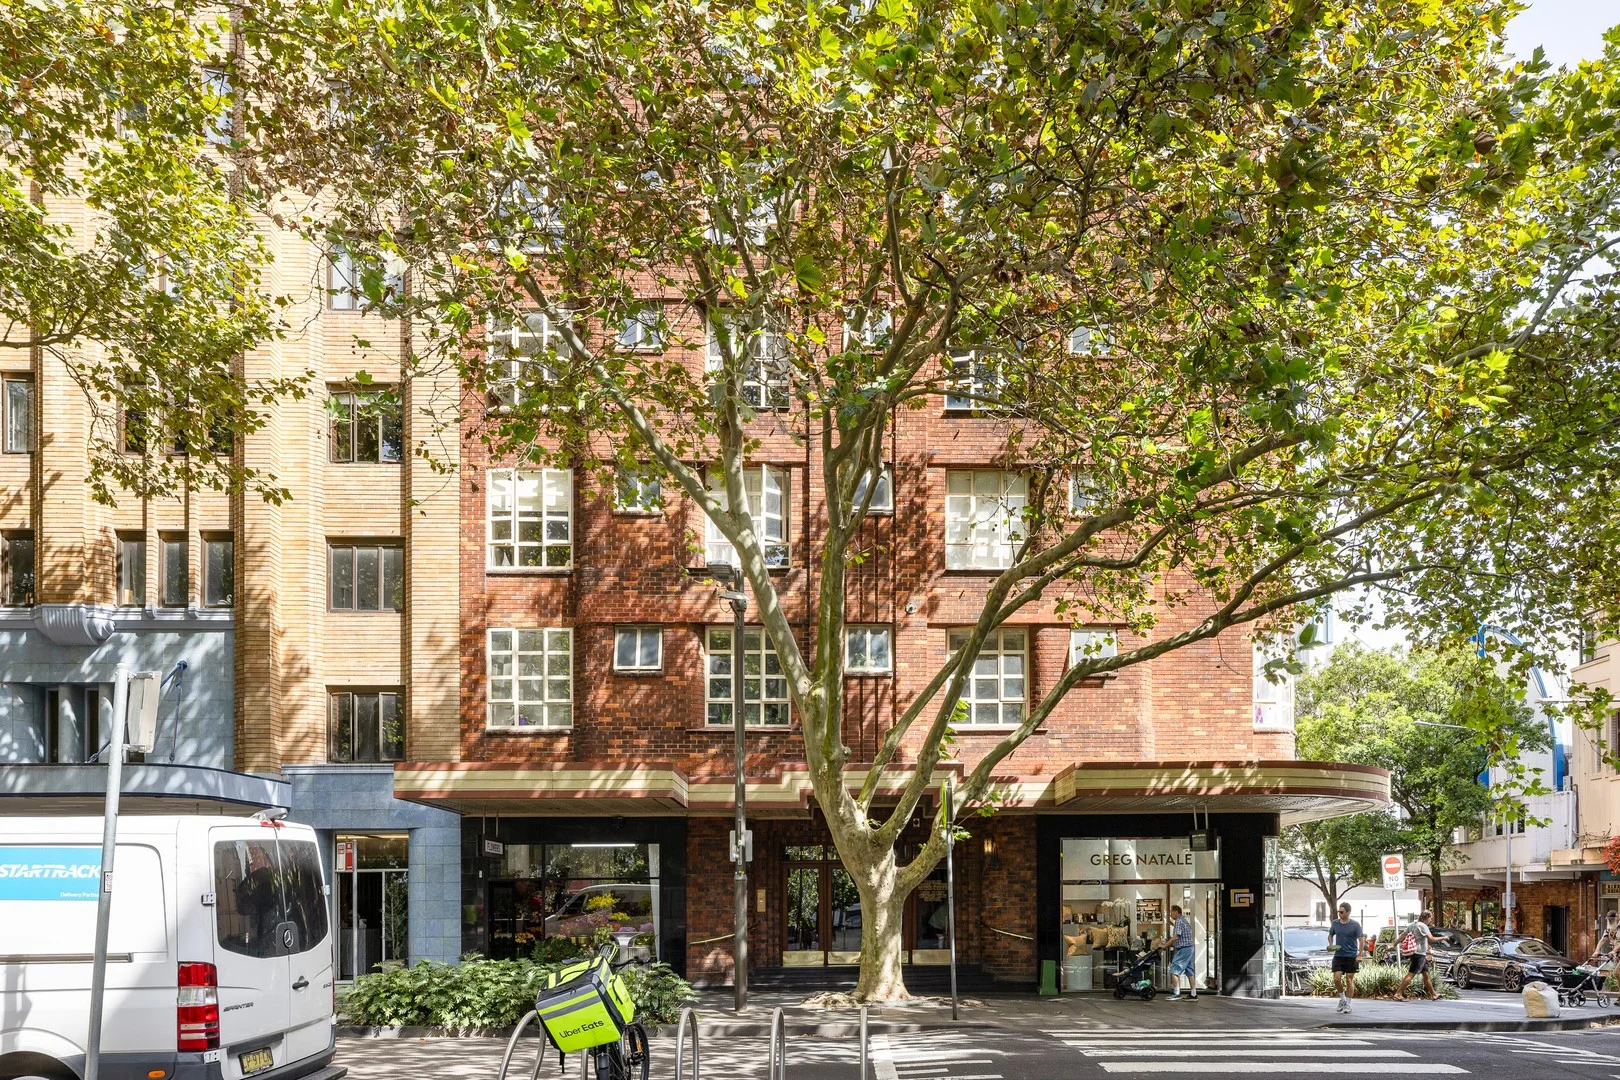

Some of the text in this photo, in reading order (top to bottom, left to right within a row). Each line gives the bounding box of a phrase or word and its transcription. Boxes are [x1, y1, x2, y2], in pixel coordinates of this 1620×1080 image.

[1090, 854, 1193, 866] GREG NATALE
[0, 864, 101, 878] STARTRACK
[559, 1020, 604, 1039] Uber Eats
